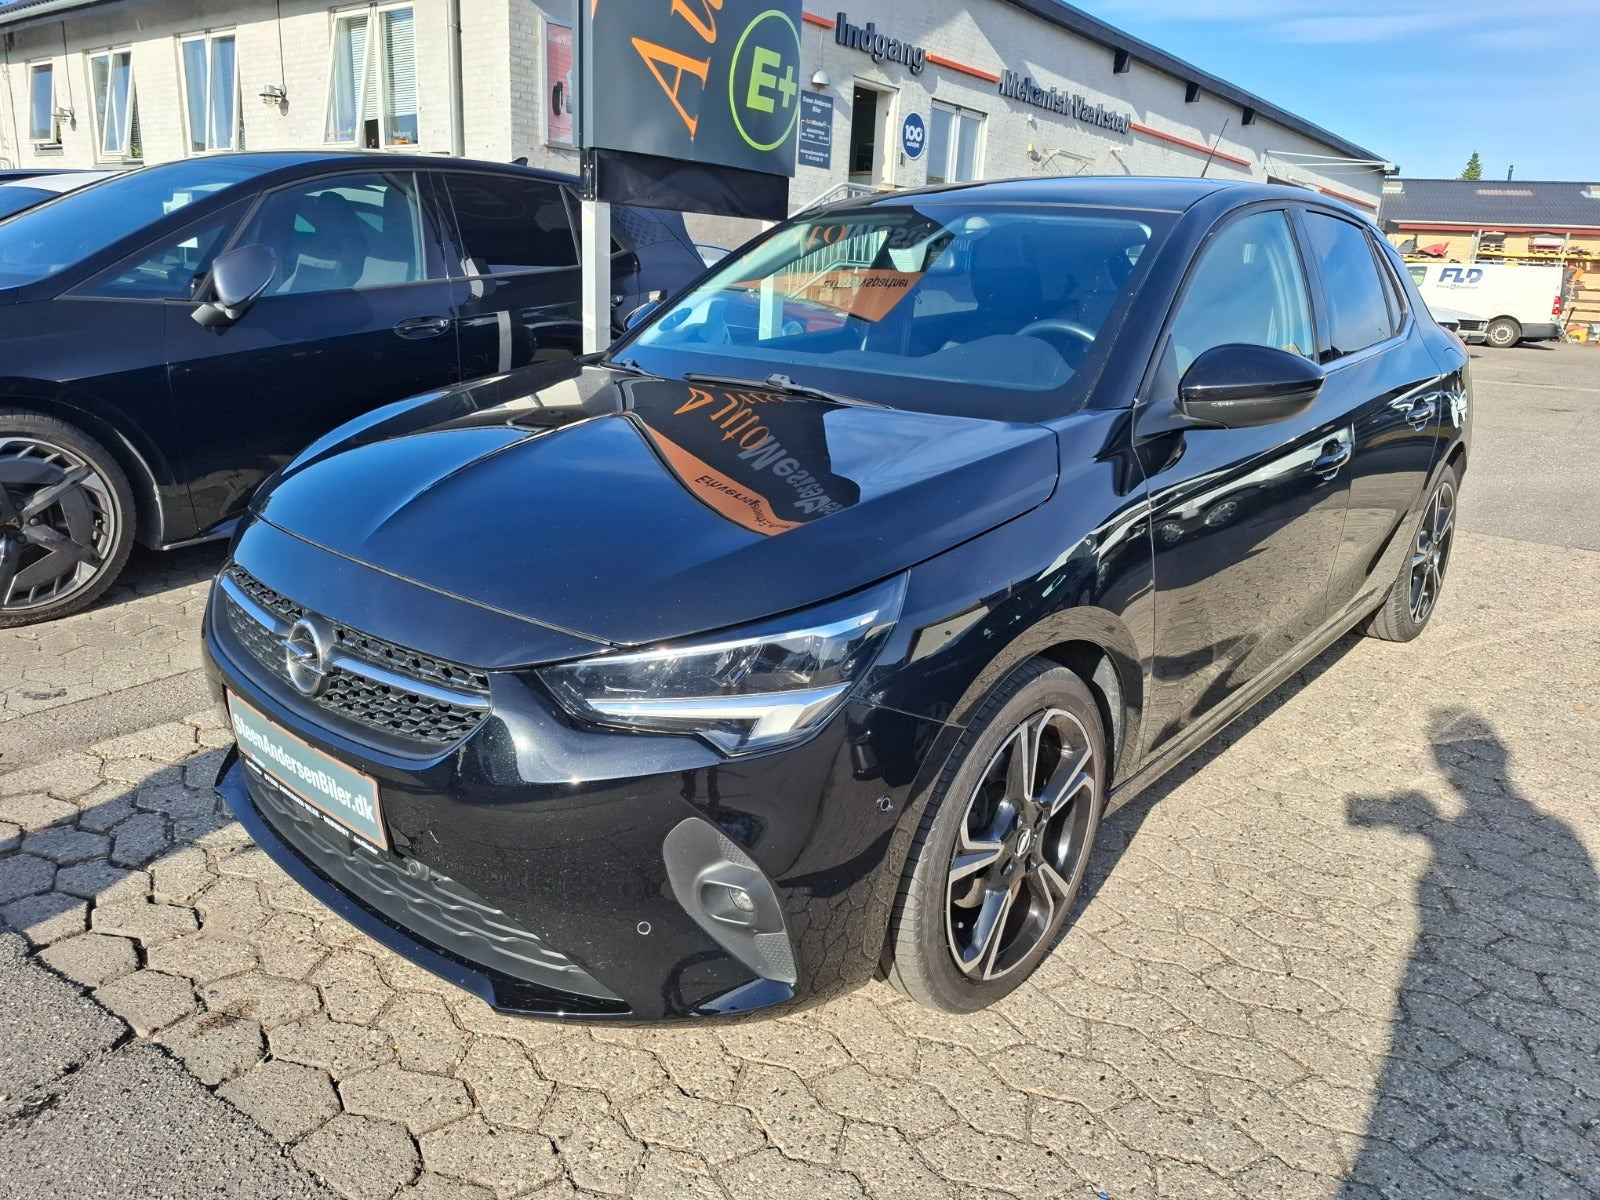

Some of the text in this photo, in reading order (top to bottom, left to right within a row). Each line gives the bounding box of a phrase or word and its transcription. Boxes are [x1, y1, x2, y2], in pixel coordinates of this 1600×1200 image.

[836, 12, 926, 76] Indgang
[999, 69, 1131, 135] Mekanisk Værksted
[1438, 267, 1484, 284] FLD
[234, 712, 376, 824] SteenAndersenBiler.dk
